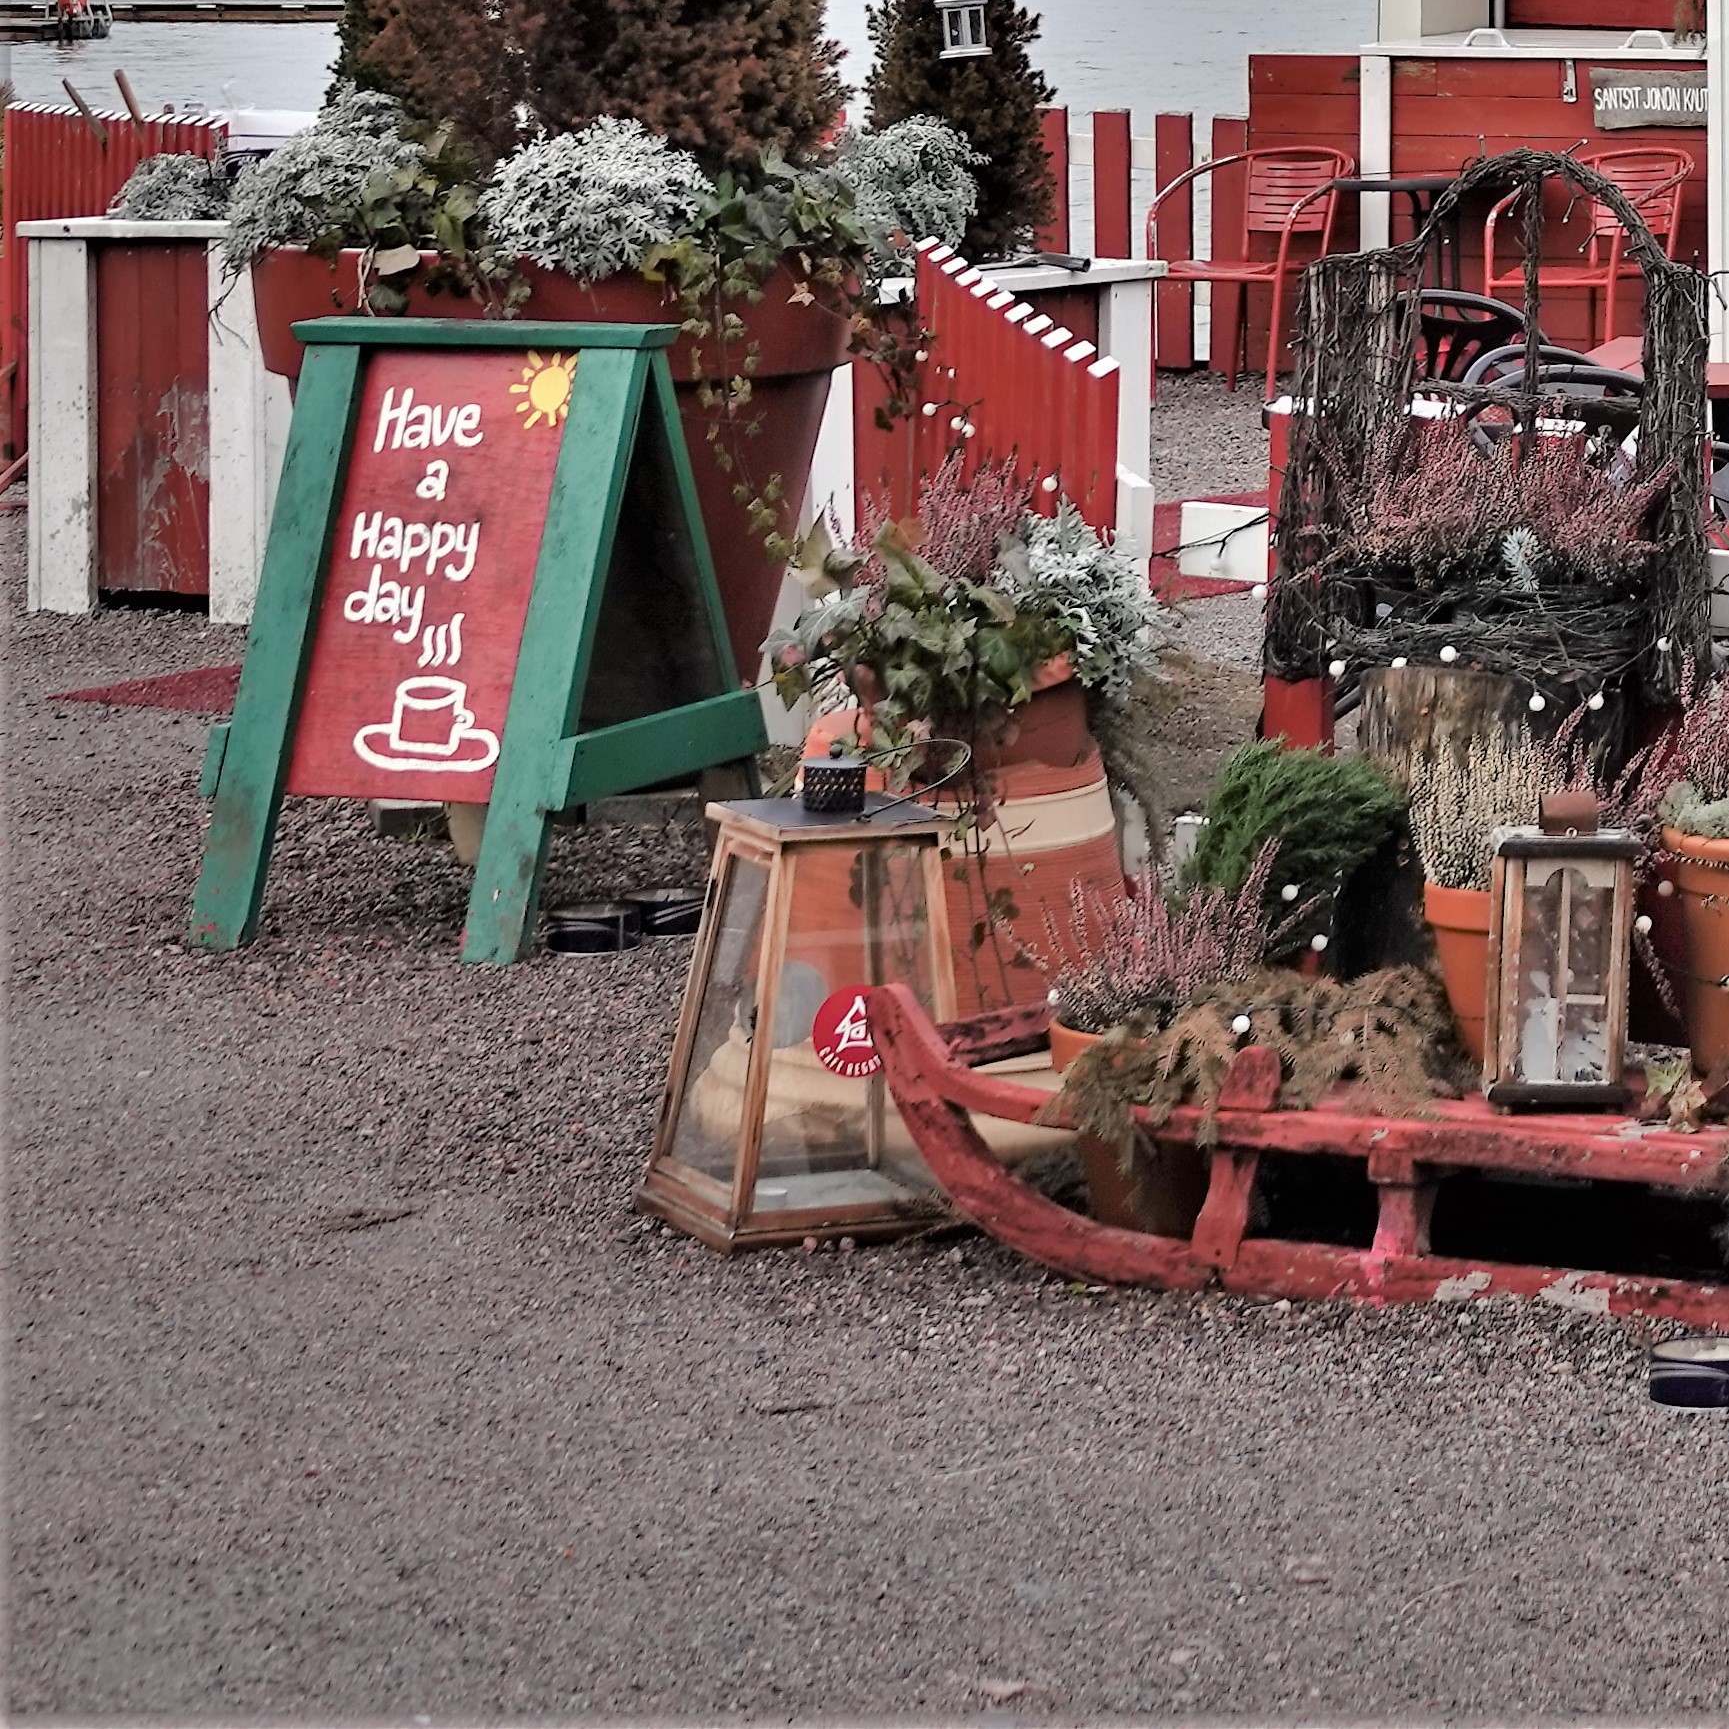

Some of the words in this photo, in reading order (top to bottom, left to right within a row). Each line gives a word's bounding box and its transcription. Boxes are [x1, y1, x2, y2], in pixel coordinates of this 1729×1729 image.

[374, 387, 484, 454] Have
[415, 458, 450, 501] a
[349, 510, 482, 583] Happy
[343, 564, 426, 645] day
